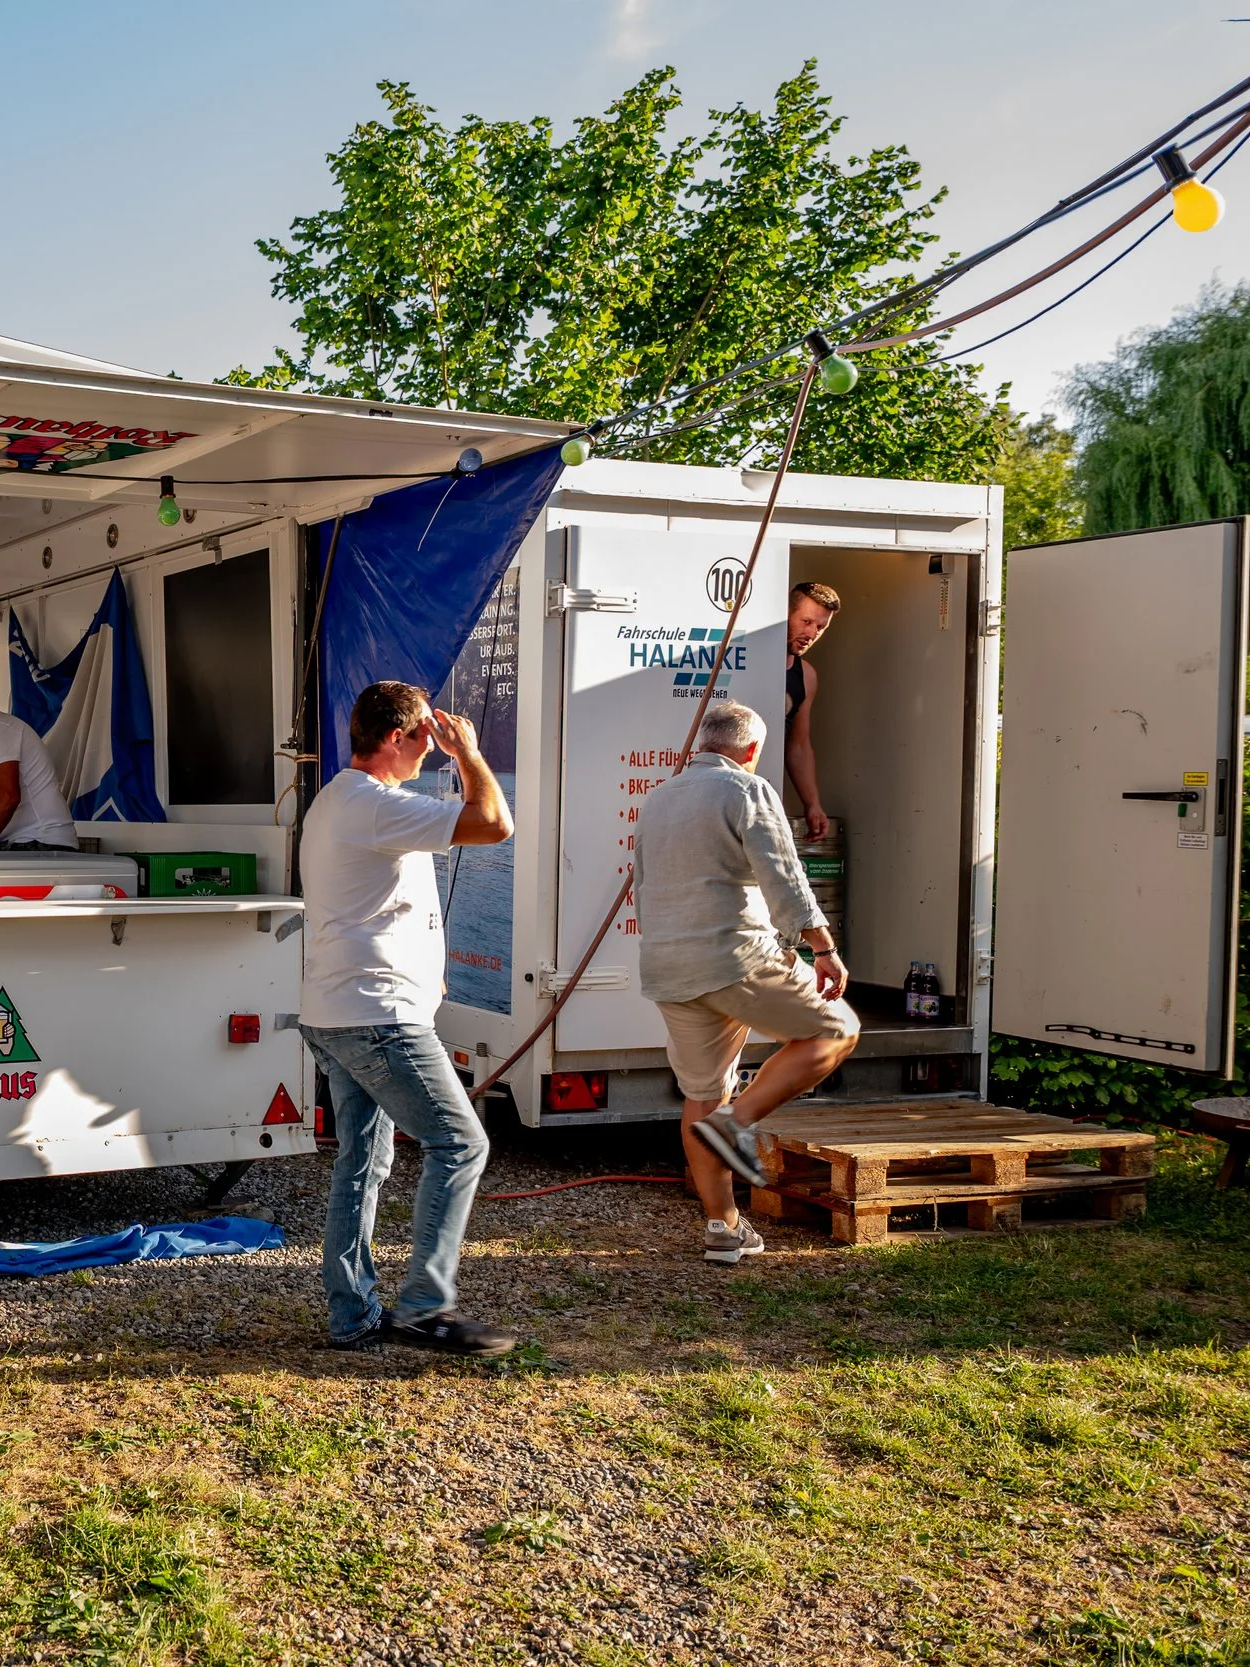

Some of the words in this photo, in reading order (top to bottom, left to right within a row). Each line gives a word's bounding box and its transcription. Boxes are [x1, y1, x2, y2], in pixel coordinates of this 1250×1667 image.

[617, 625, 686, 641] Fahrschule
[630, 643, 747, 671] HALANKE
[497, 682, 514, 695] ETC.
[673, 689, 689, 698] NEUE
[629, 750, 655, 767] ALLE
